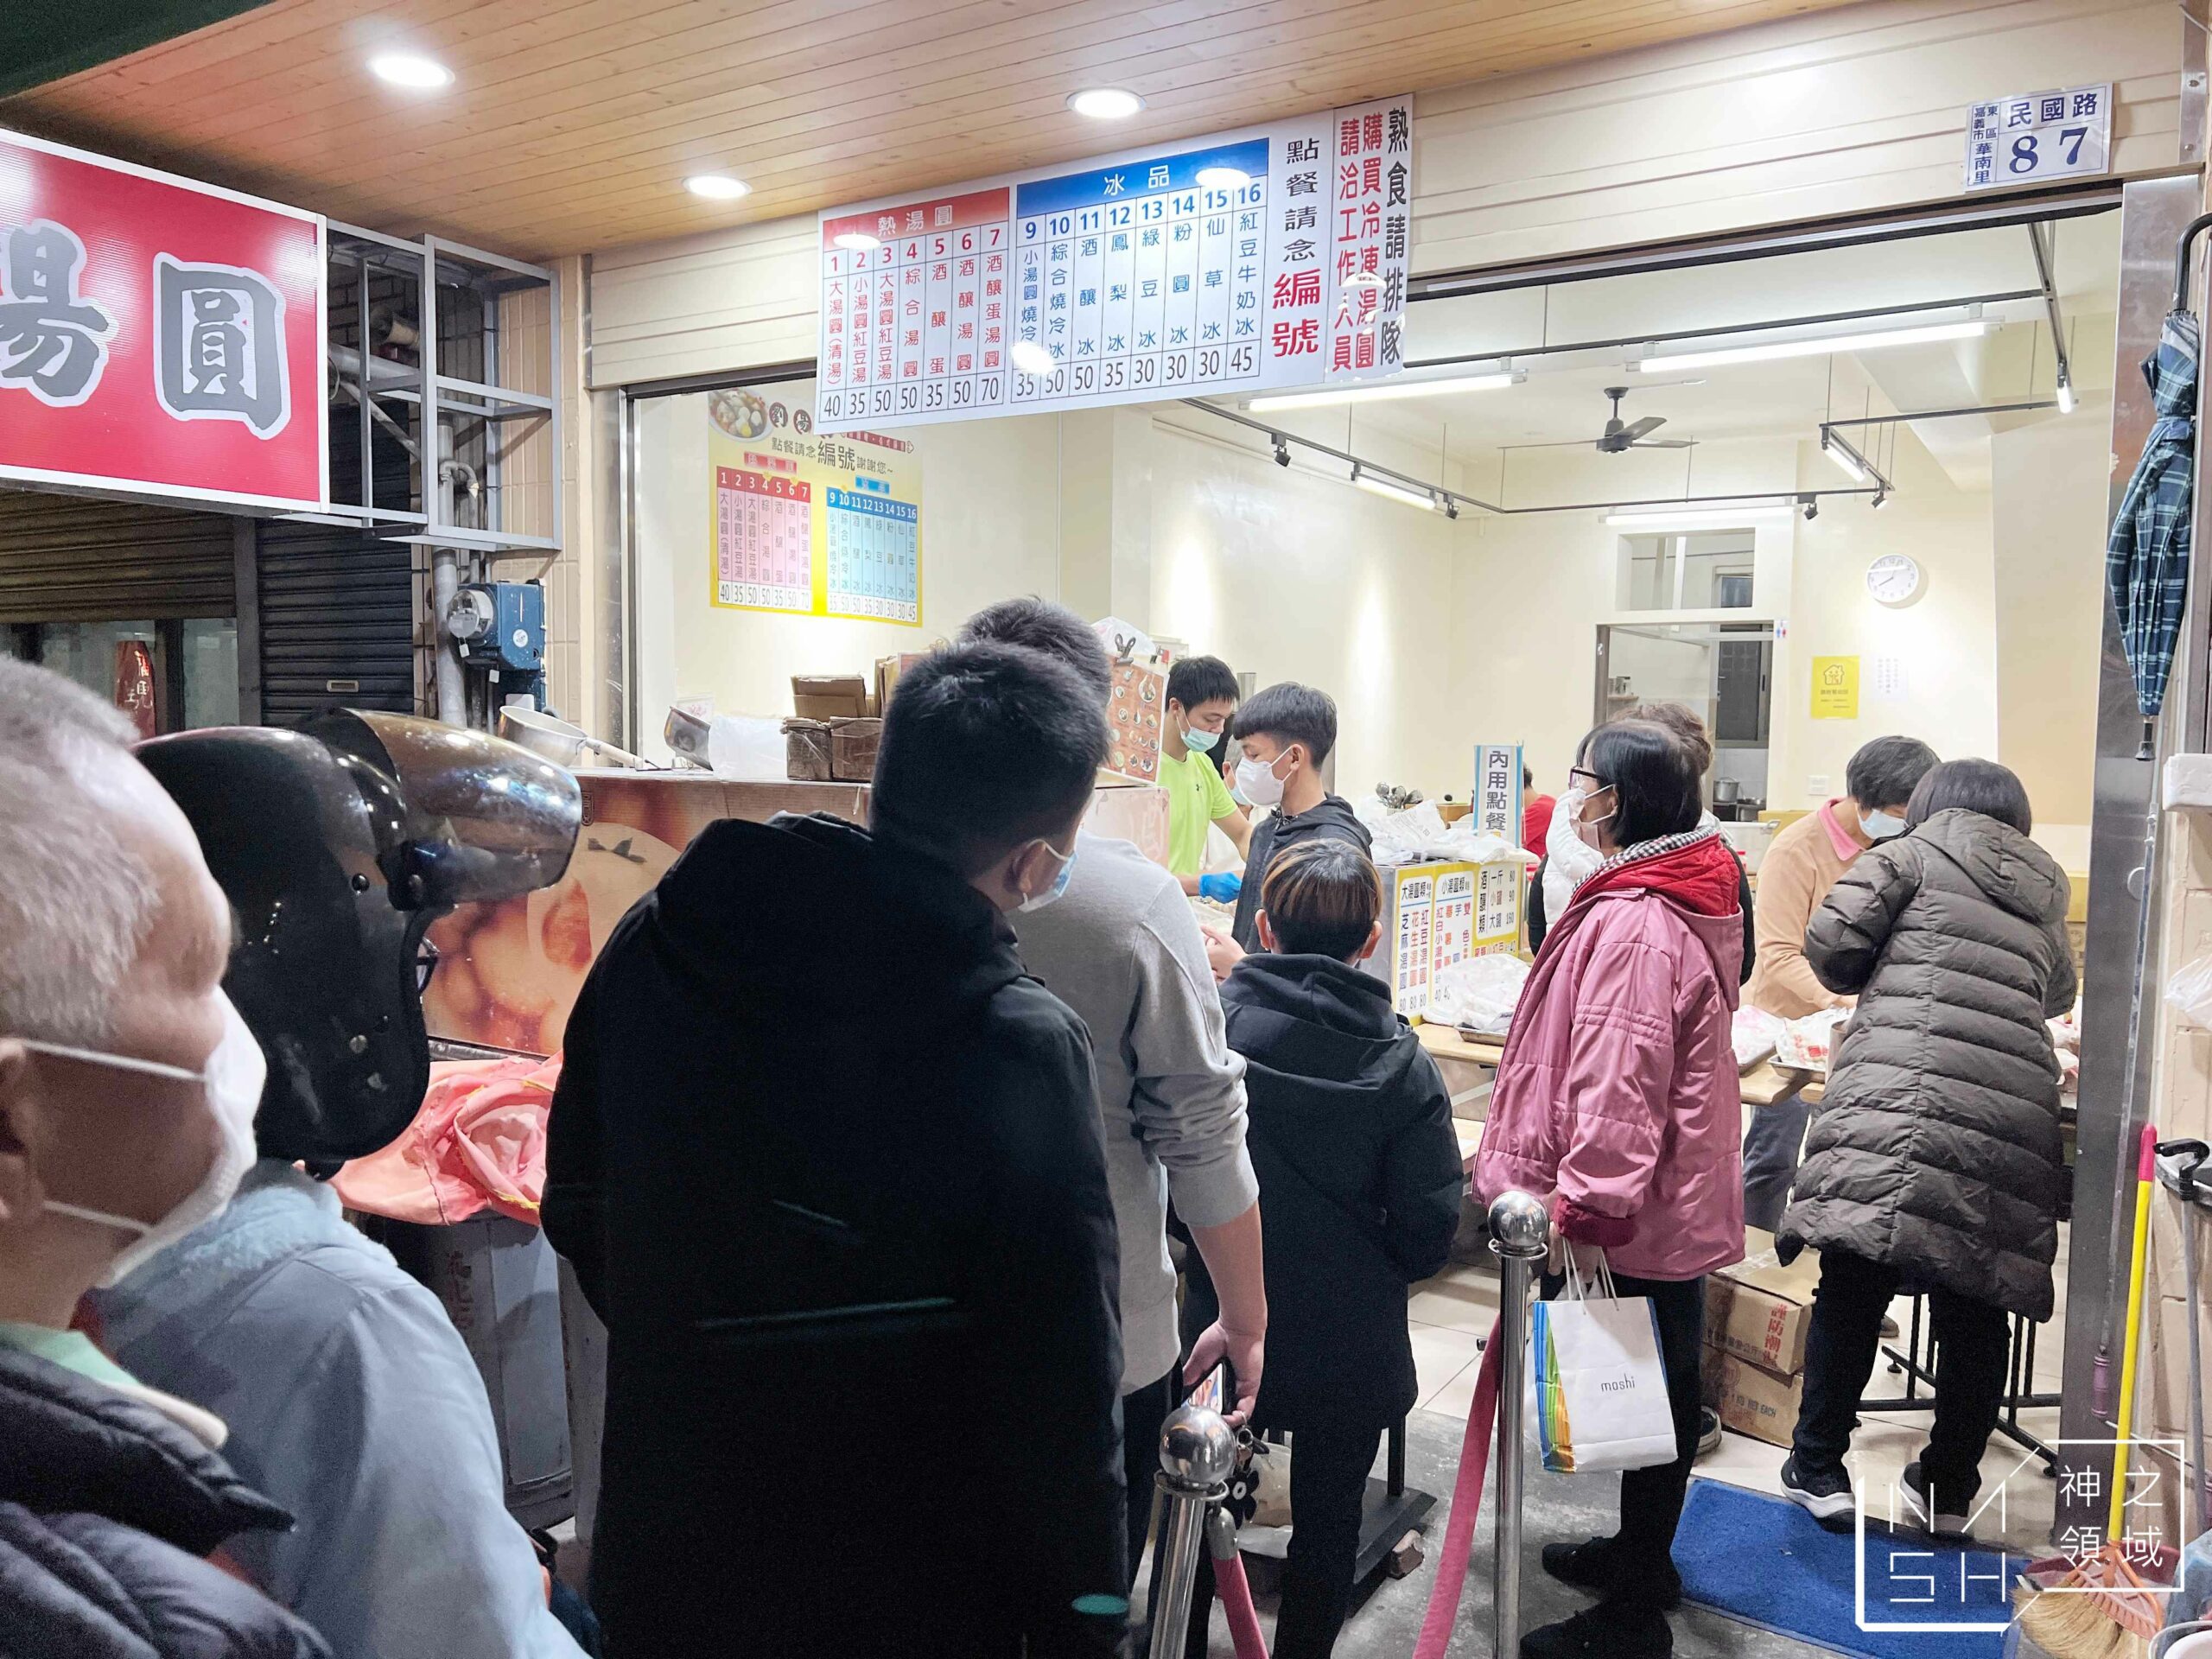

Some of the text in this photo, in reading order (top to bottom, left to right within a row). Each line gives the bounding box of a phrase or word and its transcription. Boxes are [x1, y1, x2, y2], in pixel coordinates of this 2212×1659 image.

[2008, 93, 2097, 128] 民國路
[1974, 106, 1986, 141] 嘉義市
[1986, 106, 1998, 139] 東區
[2009, 127, 2088, 174] 87
[1974, 143, 1993, 184] 華南里
[1103, 165, 1170, 196] 冰品
[1205, 189, 1228, 209] 15
[1237, 183, 1261, 204] 16
[1141, 200, 1163, 220] 13
[1173, 195, 1195, 215] 14
[878, 205, 952, 237] 熱湯圓
[1049, 216, 1070, 236] 10
[1080, 211, 1099, 231] 11
[1109, 207, 1130, 226] 12
[990, 229, 1001, 245] 7
[1026, 222, 1036, 239] 9
[1356, 113, 1382, 368] 購買冷凍湯圓
[1381, 107, 1408, 366] 熟食請排隊
[906, 243, 917, 259] 4
[935, 238, 945, 255] 5
[961, 233, 972, 250] 6
[1332, 118, 1360, 372] 請洽工作人員
[832, 256, 838, 271] 1
[856, 251, 866, 269] 2
[882, 247, 892, 264] 3
[1170, 223, 1192, 344] 粉圓冰
[1202, 216, 1225, 340] 仙草冰
[1236, 212, 1259, 335] 紅豆牛奶冰
[1020, 250, 1039, 343] 小湯圓燒冷
[1077, 238, 1097, 355] 酒釀冰
[1108, 233, 1128, 352] 鳳梨冰
[1139, 228, 1160, 347] 綠豆冰
[984, 255, 1002, 368] 酒釀蛋湯圓
[1049, 244, 1068, 359] 綜合燒冷冰
[904, 268, 921, 378] 綜合湯圓
[930, 264, 947, 374] 酒釀蛋
[957, 258, 975, 371] 酒釀湯圓
[852, 276, 868, 384] 小湯圓紅豆湯
[877, 272, 894, 380] 大湯圓紅豆湯
[1166, 354, 1187, 380] 30
[1198, 350, 1220, 376] 30
[1231, 346, 1253, 372] 45
[1046, 368, 1065, 393] 50
[1074, 365, 1094, 391] 50
[1104, 361, 1123, 387] 35
[1135, 359, 1154, 384] 30
[953, 381, 971, 404] 50
[982, 378, 999, 401] 70
[1016, 372, 1034, 396] 35
[849, 392, 865, 415] 35
[875, 390, 891, 412] 50
[901, 387, 918, 410] 50
[926, 384, 943, 407] 35
[824, 395, 841, 417] 40
[721, 472, 727, 484] 1
[735, 474, 741, 486] 2
[749, 477, 754, 489] 3
[762, 480, 768, 491] 4
[776, 482, 782, 493] 5
[789, 484, 795, 496] 6
[802, 486, 807, 499] 7
[830, 492, 836, 503] 9
[839, 493, 849, 505] 10
[851, 496, 861, 509] 11
[863, 499, 873, 511] 12
[874, 501, 884, 513] 13
[885, 503, 895, 515] 14
[896, 505, 906, 518] 15
[907, 508, 916, 519] 16
[720, 584, 729, 601] 40
[734, 585, 743, 602] 35
[748, 587, 757, 604] 50
[761, 588, 770, 606] 50
[774, 590, 783, 607] 35
[864, 599, 872, 614] 35
[875, 601, 883, 616] 30
[887, 601, 894, 617] 30
[898, 604, 906, 619] 30
[908, 606, 916, 620] 45
[1485, 750, 1509, 831] 內用點餐
[1399, 997, 1407, 1012] 80
[1409, 995, 1417, 1010] 80
[1420, 993, 1427, 1008] 80
[1601, 1374, 1636, 1393] moshi
